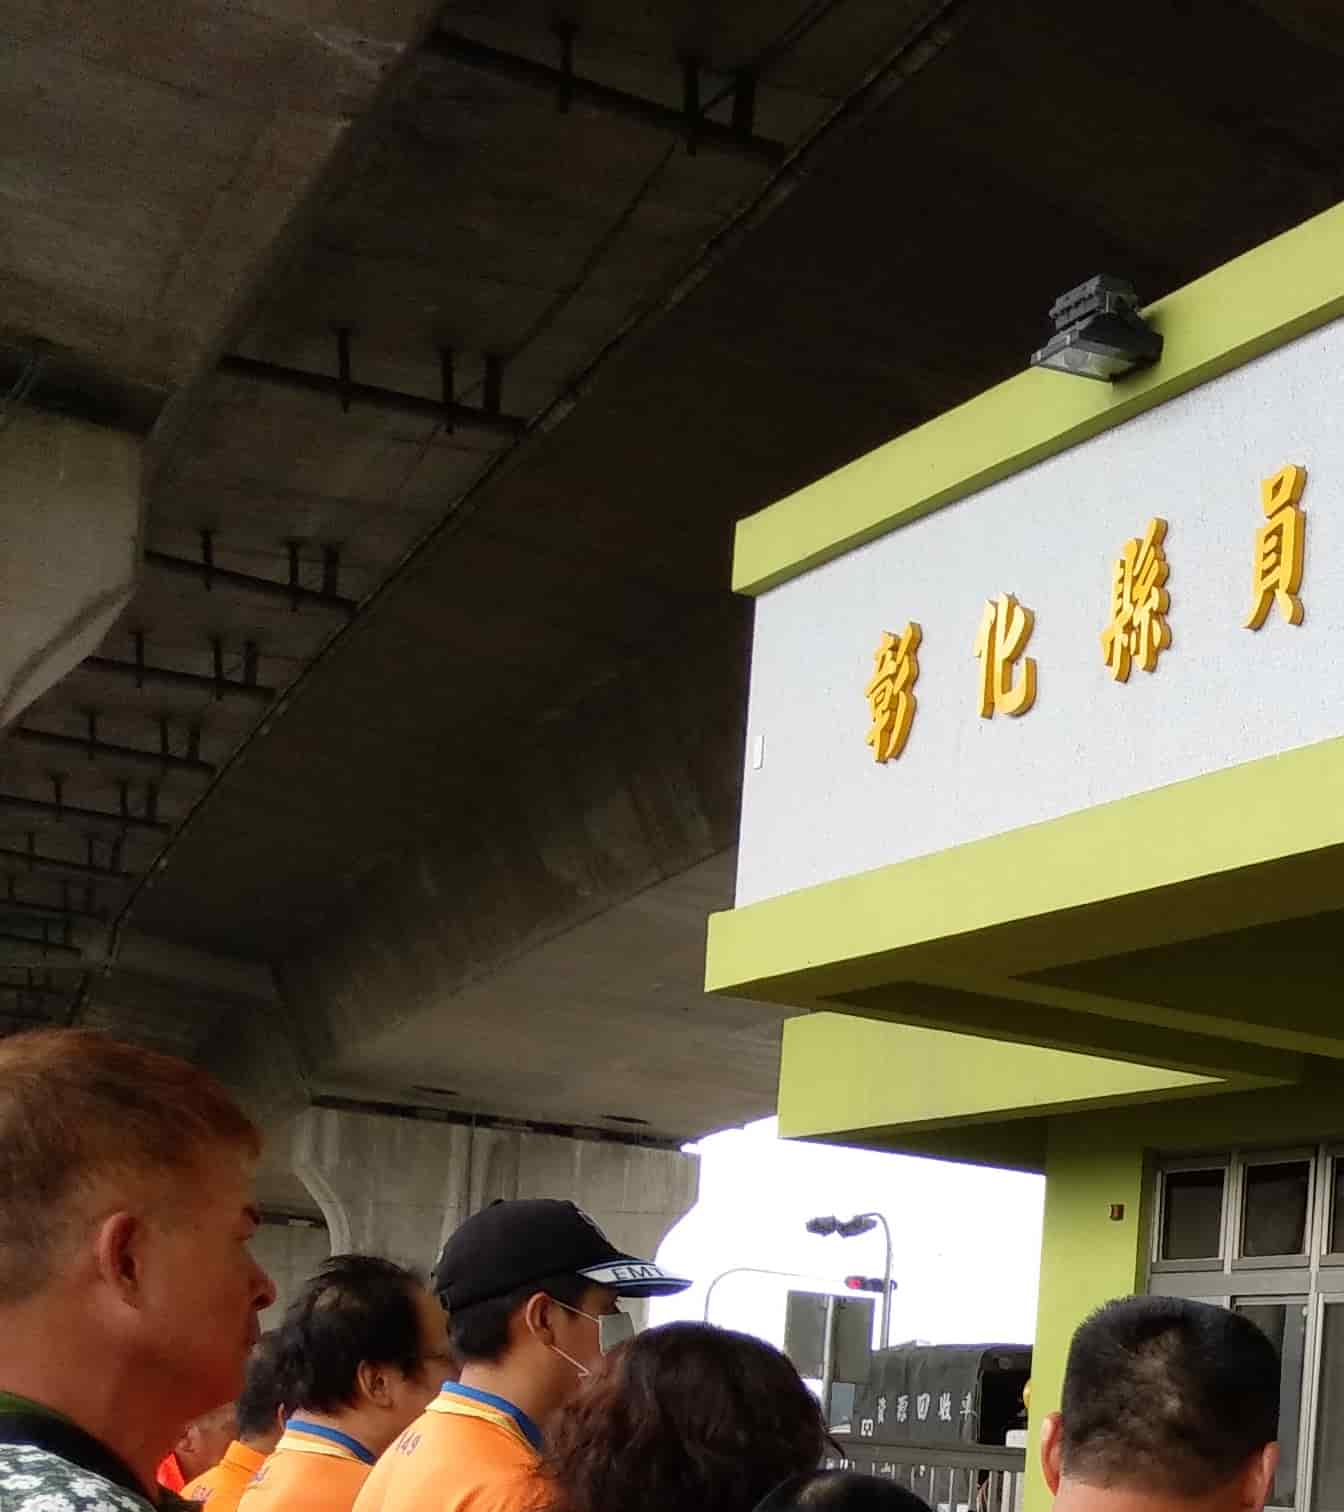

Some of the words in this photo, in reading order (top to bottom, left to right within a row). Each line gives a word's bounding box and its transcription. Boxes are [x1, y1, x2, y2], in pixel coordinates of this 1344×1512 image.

[876, 1391, 978, 1424] 資源回收車
